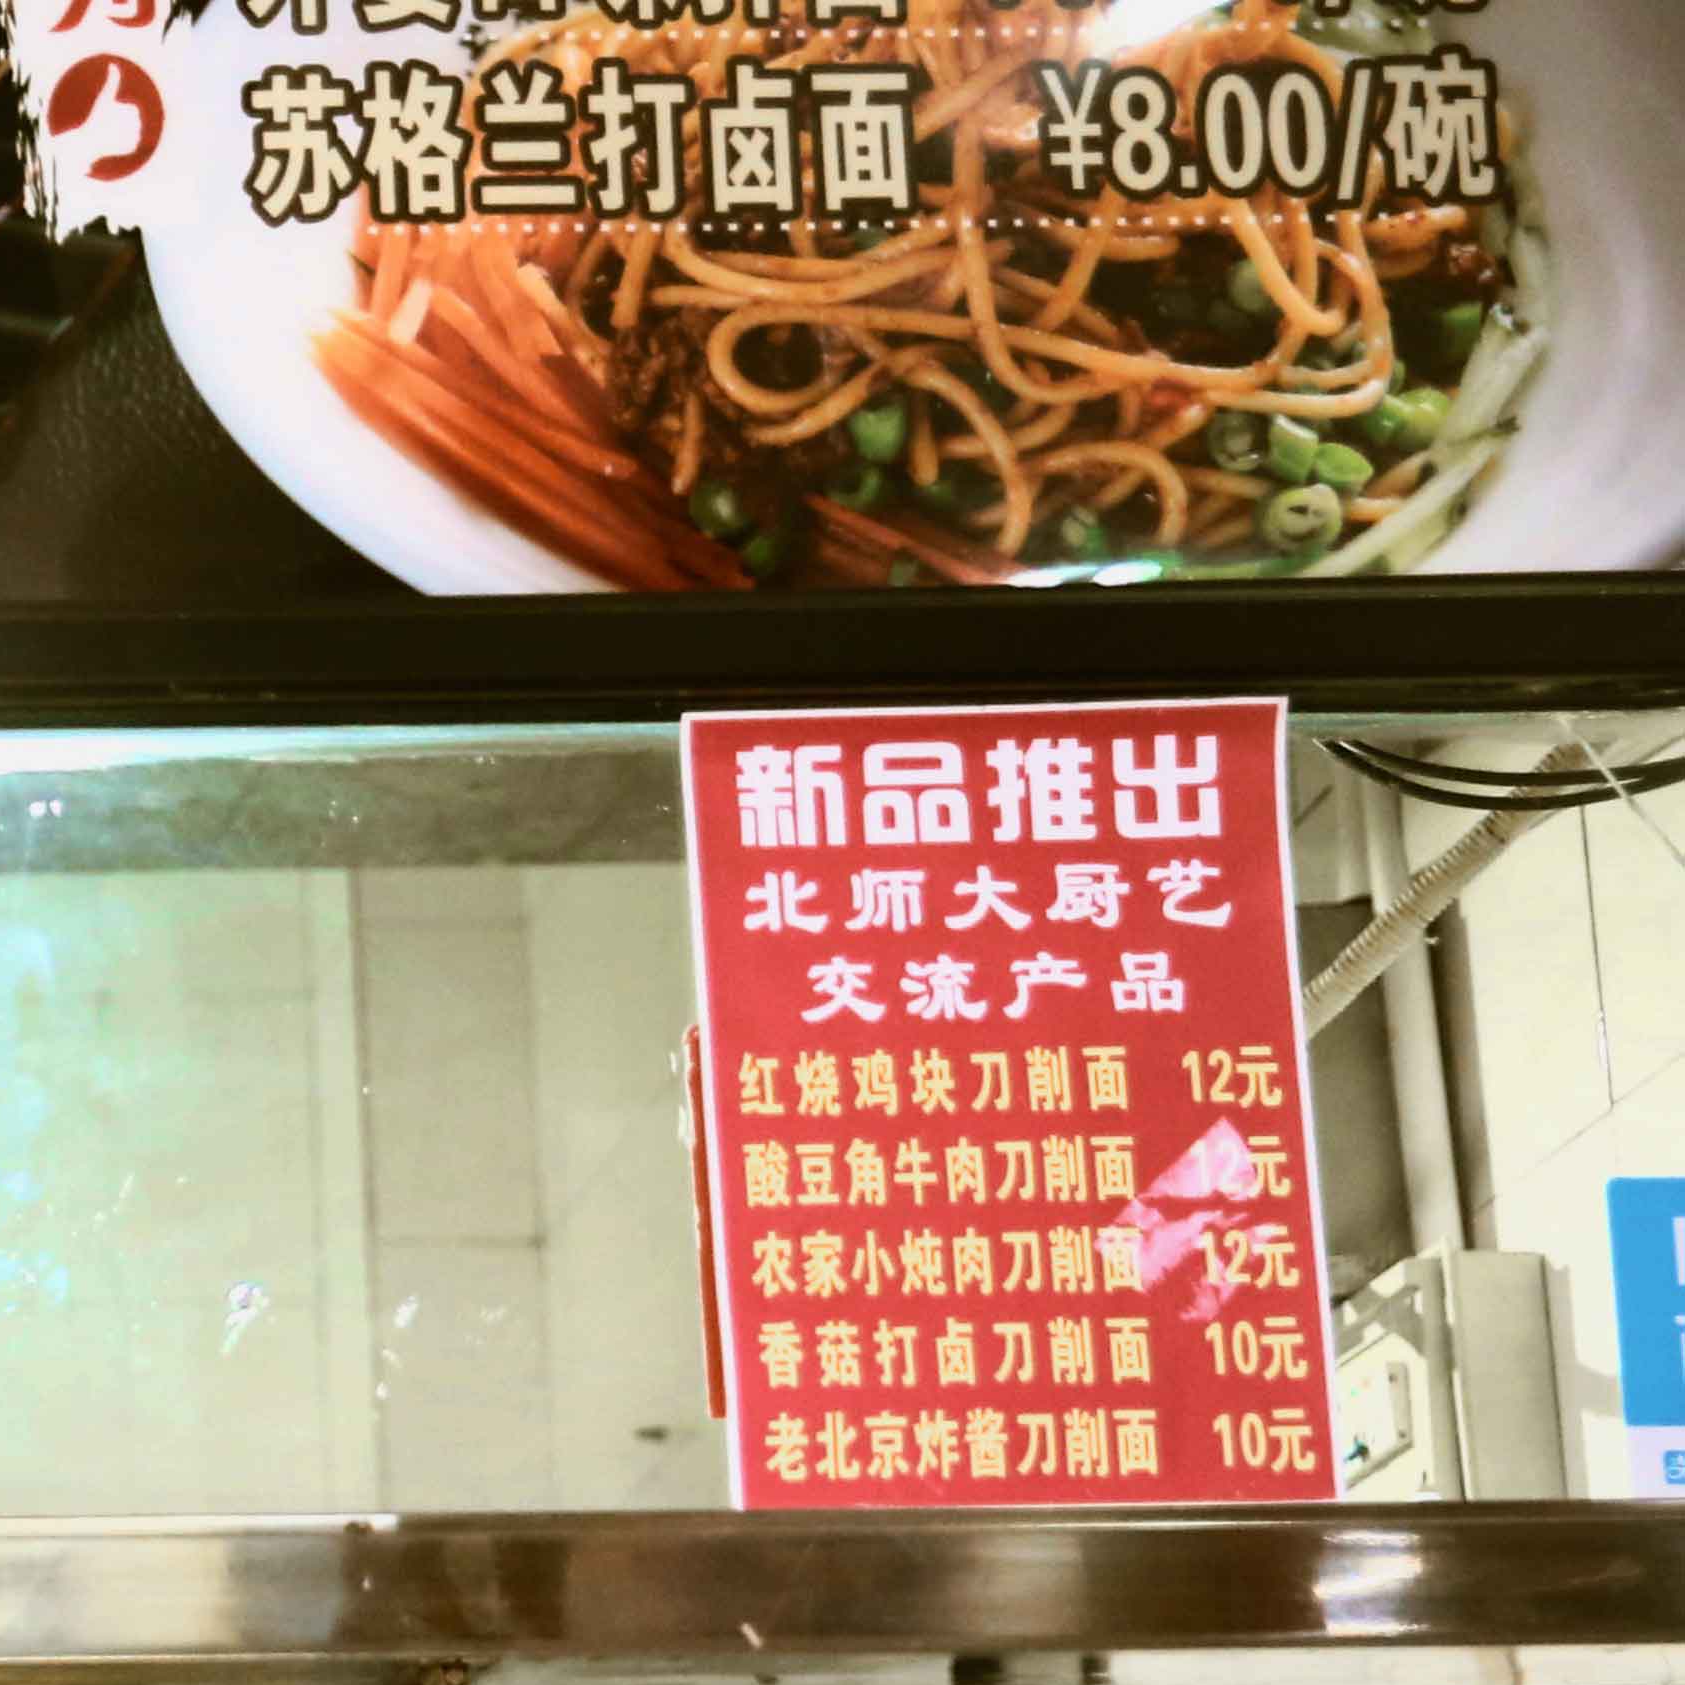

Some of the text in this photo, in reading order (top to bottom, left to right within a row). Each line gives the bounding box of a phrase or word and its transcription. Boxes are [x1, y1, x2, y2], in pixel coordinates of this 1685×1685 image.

[251, 54, 1495, 217] 苏格兰打卤面 ¥8.00/碗
[737, 735, 1220, 847] 新品推出
[744, 860, 1231, 933] 北师大厨艺
[802, 952, 1183, 1022] 交流产品
[739, 1046, 1282, 1116] 红烧鸡块刀削面 12元
[743, 1135, 1135, 1207] 酸豆角牛肉刀削面
[752, 1225, 1300, 1297] 农家小炖肉刀削面 12元
[759, 1317, 1308, 1388] 香菇打卤刀削面 10元
[765, 1408, 1315, 1482] 老北京炸酱刀削面 10元
